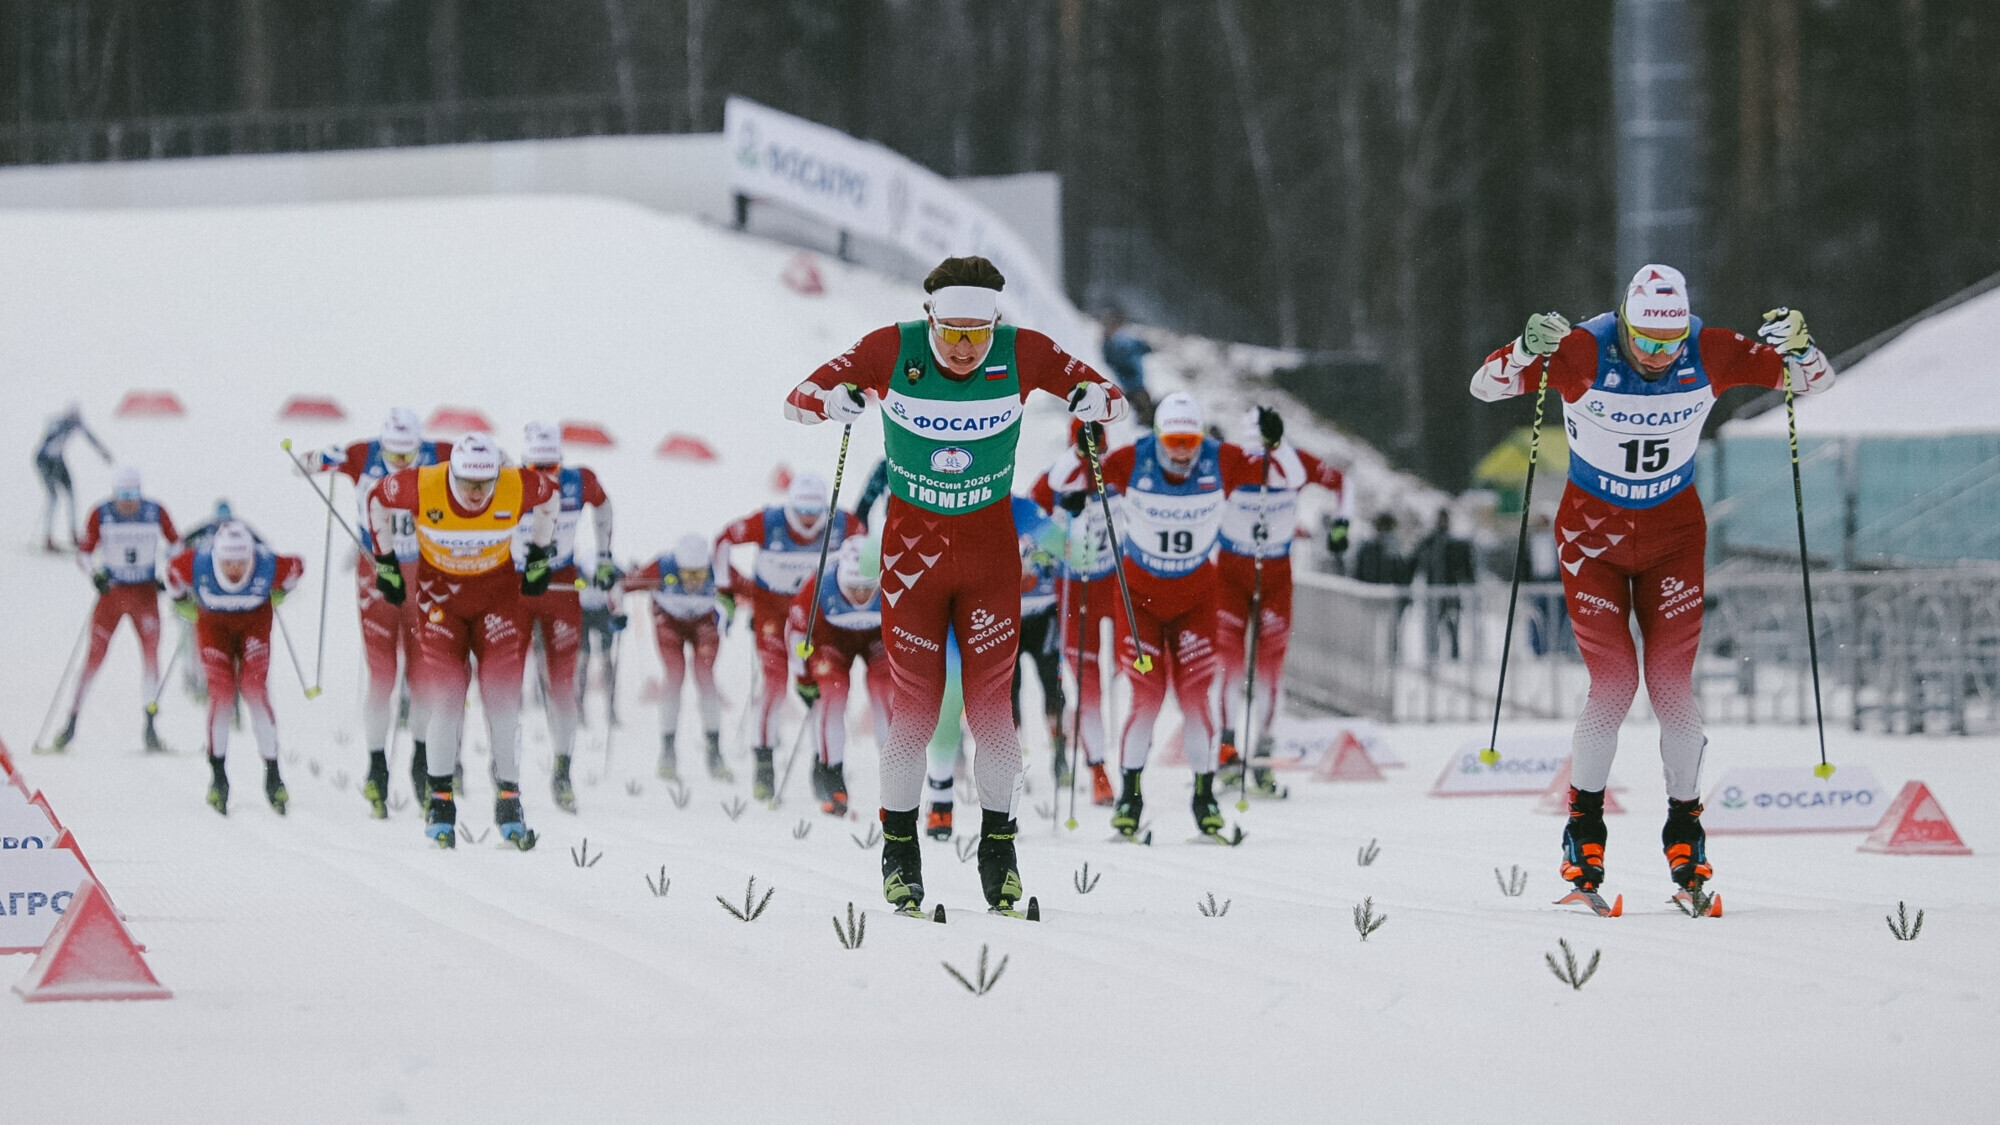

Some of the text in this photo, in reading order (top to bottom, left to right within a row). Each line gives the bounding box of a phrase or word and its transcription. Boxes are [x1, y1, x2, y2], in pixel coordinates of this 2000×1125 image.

[913, 409, 1012, 431] ФОСАГРО
[1610, 402, 1704, 426] ФОСАГРО
[1618, 438, 1670, 474] 15
[888, 457, 917, 480] Кубок
[919, 474, 962, 489] России
[964, 474, 991, 488] 2026
[907, 481, 993, 509] ТЮМЕНЬ
[1598, 474, 1682, 500] ТЮМЕНЬ
[1156, 530, 1193, 553] 19
[1575, 591, 1620, 614] ЛУКОЙЛ
[1658, 585, 1700, 611] ФОСАГРО
[1664, 596, 1703, 619] BIVIUM
[891, 625, 940, 652] ЛУКОЙЛ
[967, 617, 1012, 645] ФОСАГРО
[974, 628, 1015, 654] BIVIUM
[1753, 790, 1873, 809] ФОСАГРО
[0, 890, 73, 917] ГРО
